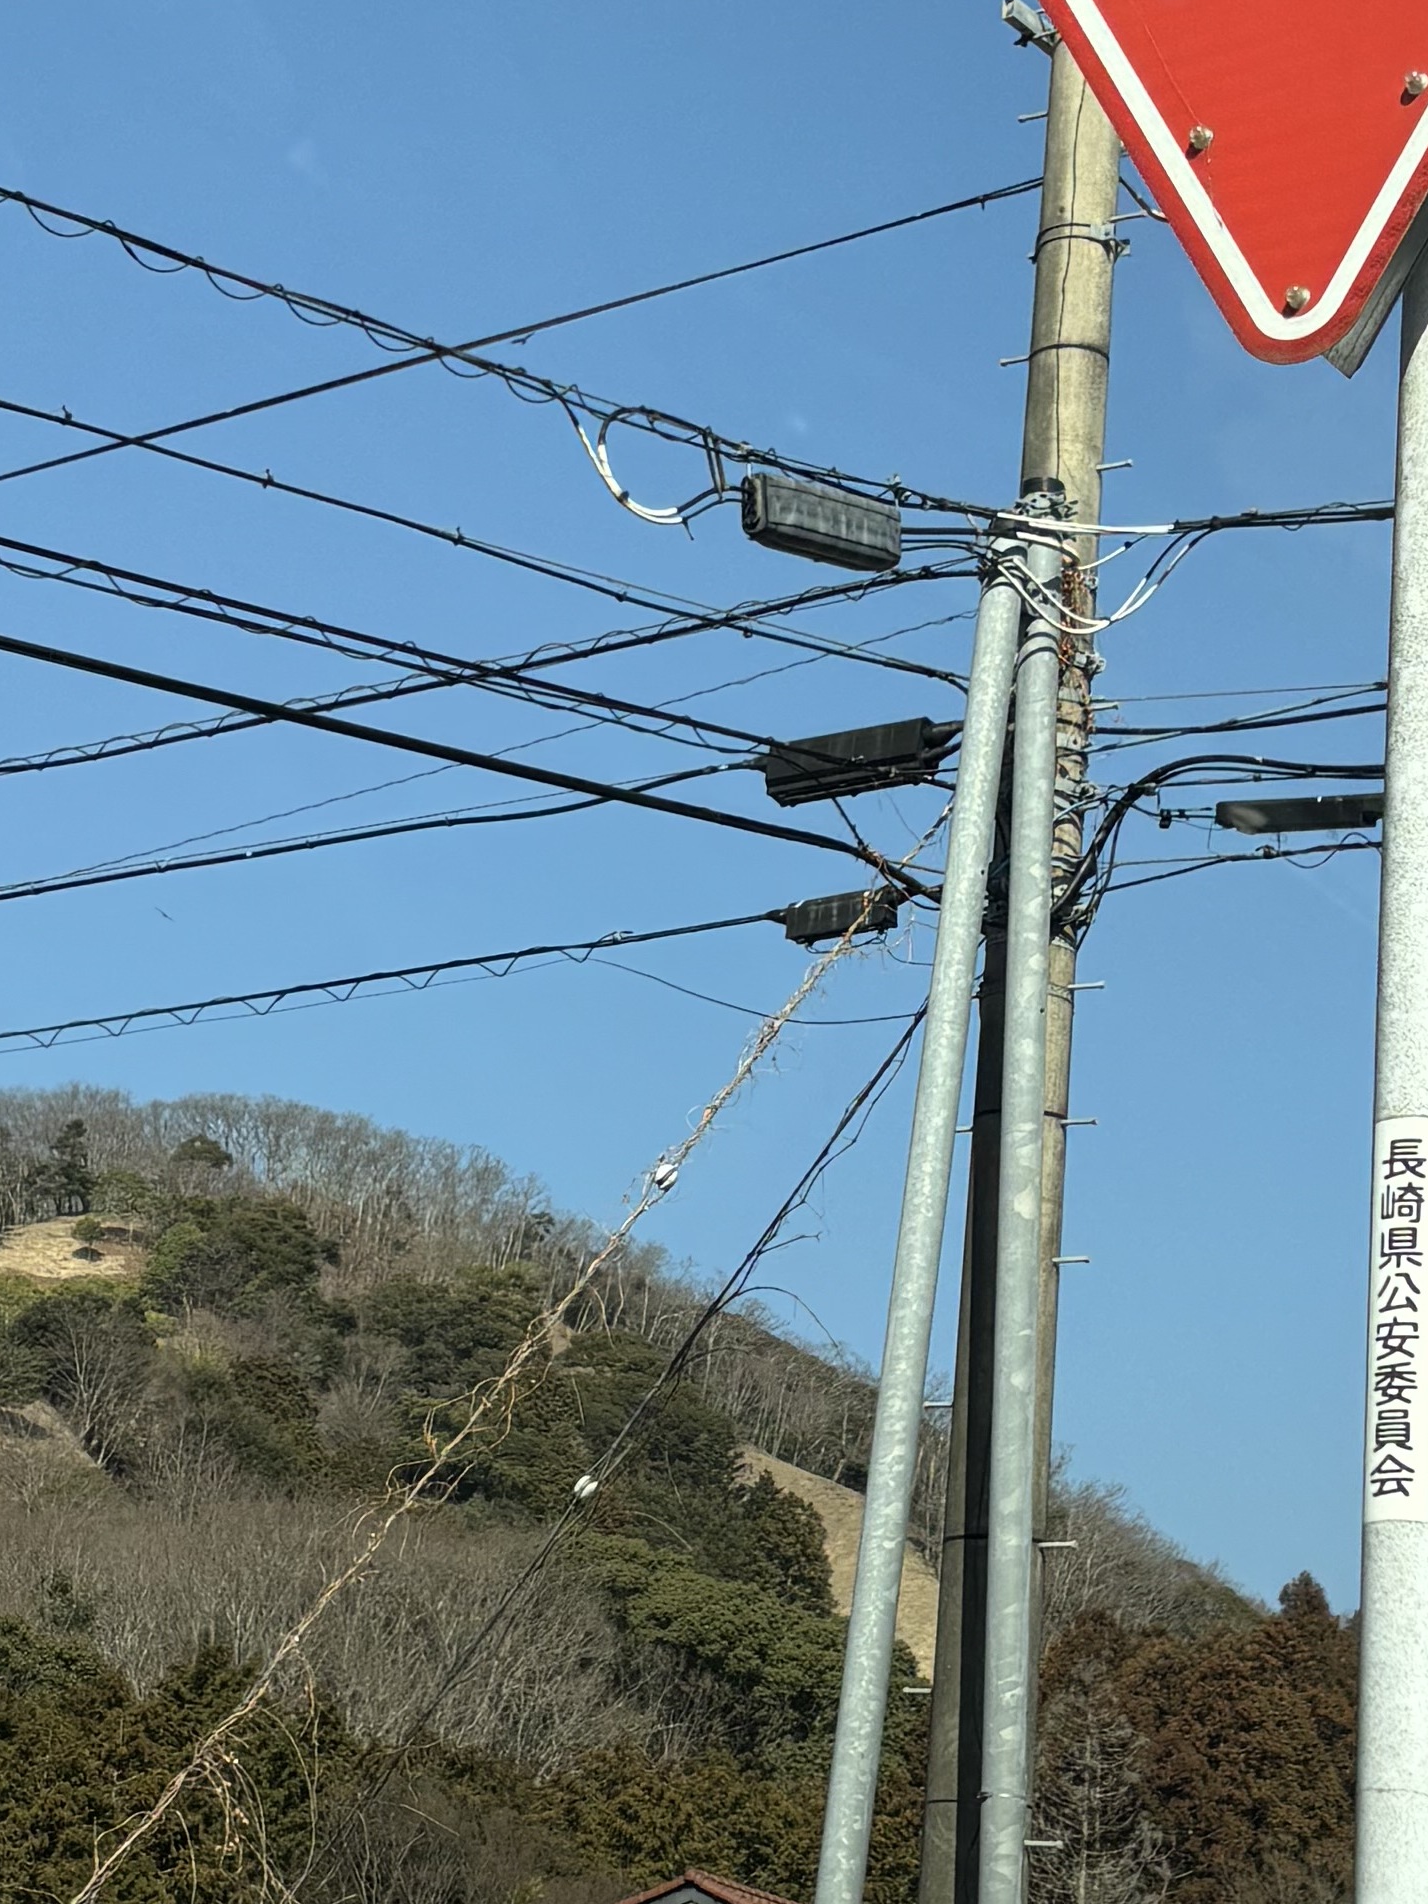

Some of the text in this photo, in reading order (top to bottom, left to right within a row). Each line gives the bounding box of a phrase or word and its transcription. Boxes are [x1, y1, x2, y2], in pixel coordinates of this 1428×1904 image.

[1370, 1138, 1427, 1497] 長崎県公安委員会
